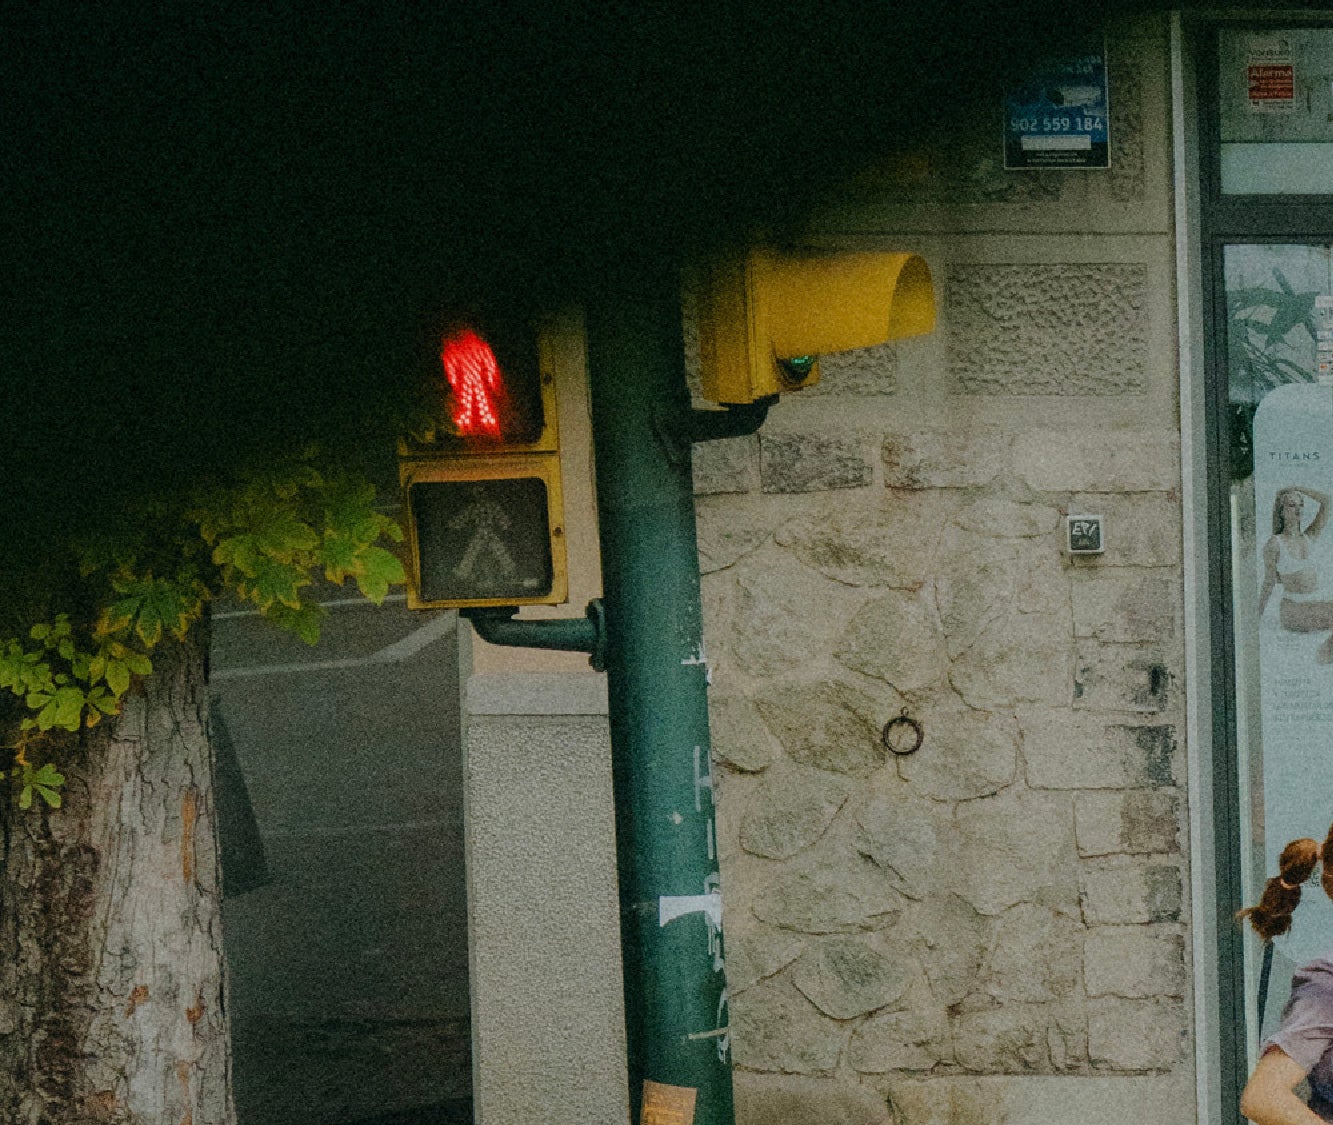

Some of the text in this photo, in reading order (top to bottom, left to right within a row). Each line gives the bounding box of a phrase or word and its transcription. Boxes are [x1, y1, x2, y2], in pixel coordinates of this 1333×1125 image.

[1010, 118, 1103, 131] 902 559 184
[1268, 452, 1321, 461] TITANS
